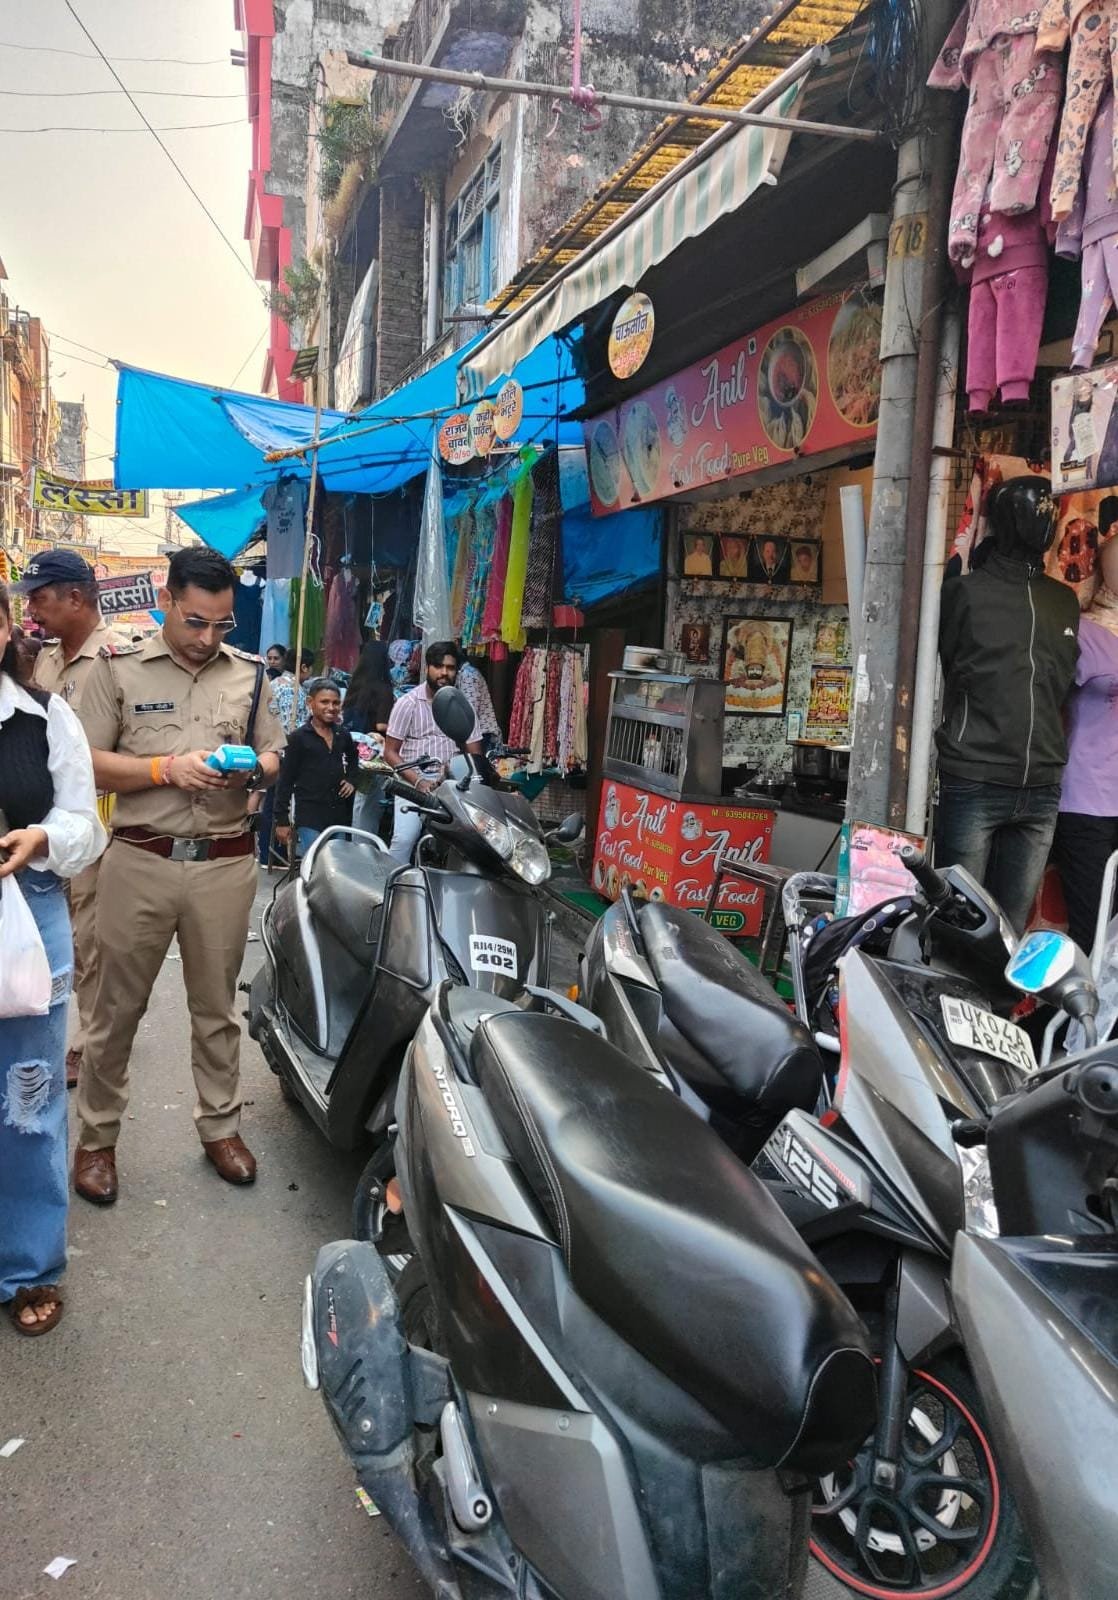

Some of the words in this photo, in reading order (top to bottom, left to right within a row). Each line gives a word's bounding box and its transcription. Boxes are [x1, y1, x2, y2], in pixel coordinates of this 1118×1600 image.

[691, 351, 748, 431] Anil
[752, 446, 769, 464] Veg
[99, 576, 152, 608] लस्सी
[621, 793, 668, 841] Anil
[599, 831, 617, 857] Fast
[618, 840, 644, 870] Food
[680, 829, 764, 873] Anil
[673, 878, 713, 902] Fast
[718, 881, 760, 905] Food
[716, 914, 737, 926] VEG
[476, 953, 514, 970] 402
[433, 1066, 467, 1137] NTORQ
